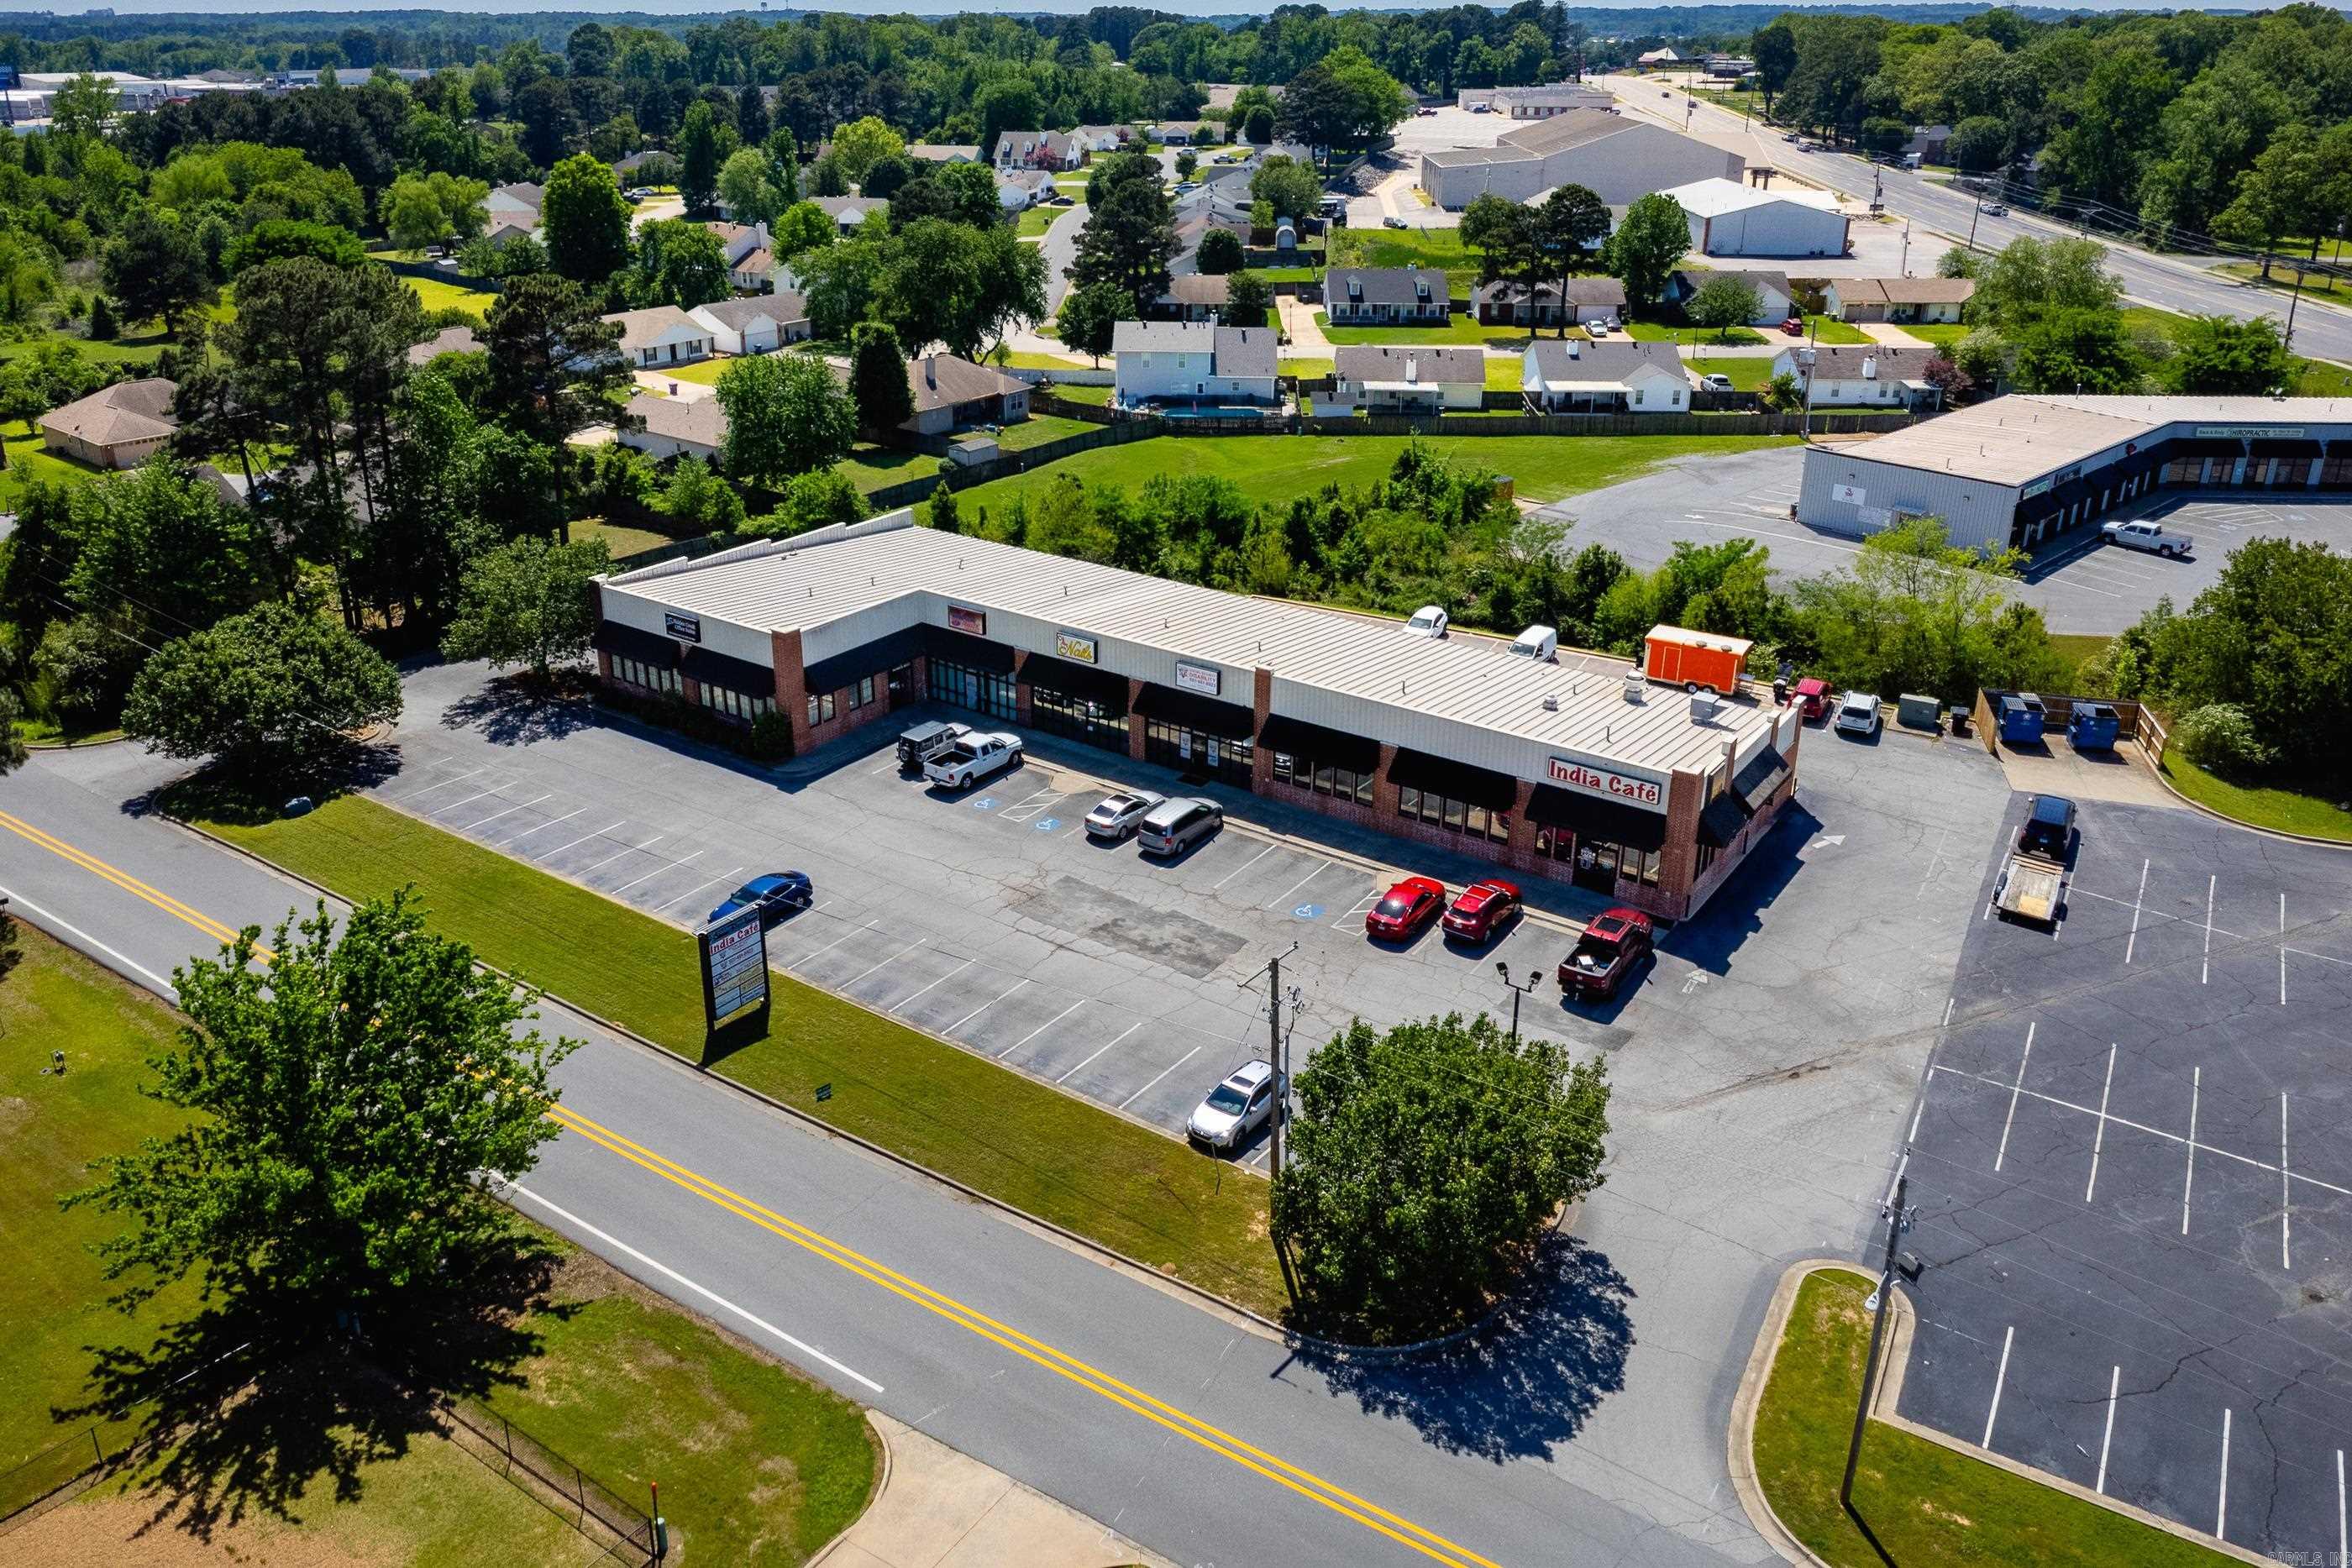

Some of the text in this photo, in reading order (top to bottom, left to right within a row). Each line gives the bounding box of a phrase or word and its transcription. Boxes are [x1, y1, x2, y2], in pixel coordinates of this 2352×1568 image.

[1068, 640, 1093, 659] Nails
[1550, 760, 1656, 802] India Café
[710, 935, 735, 955] India
[737, 923, 759, 939] Café
